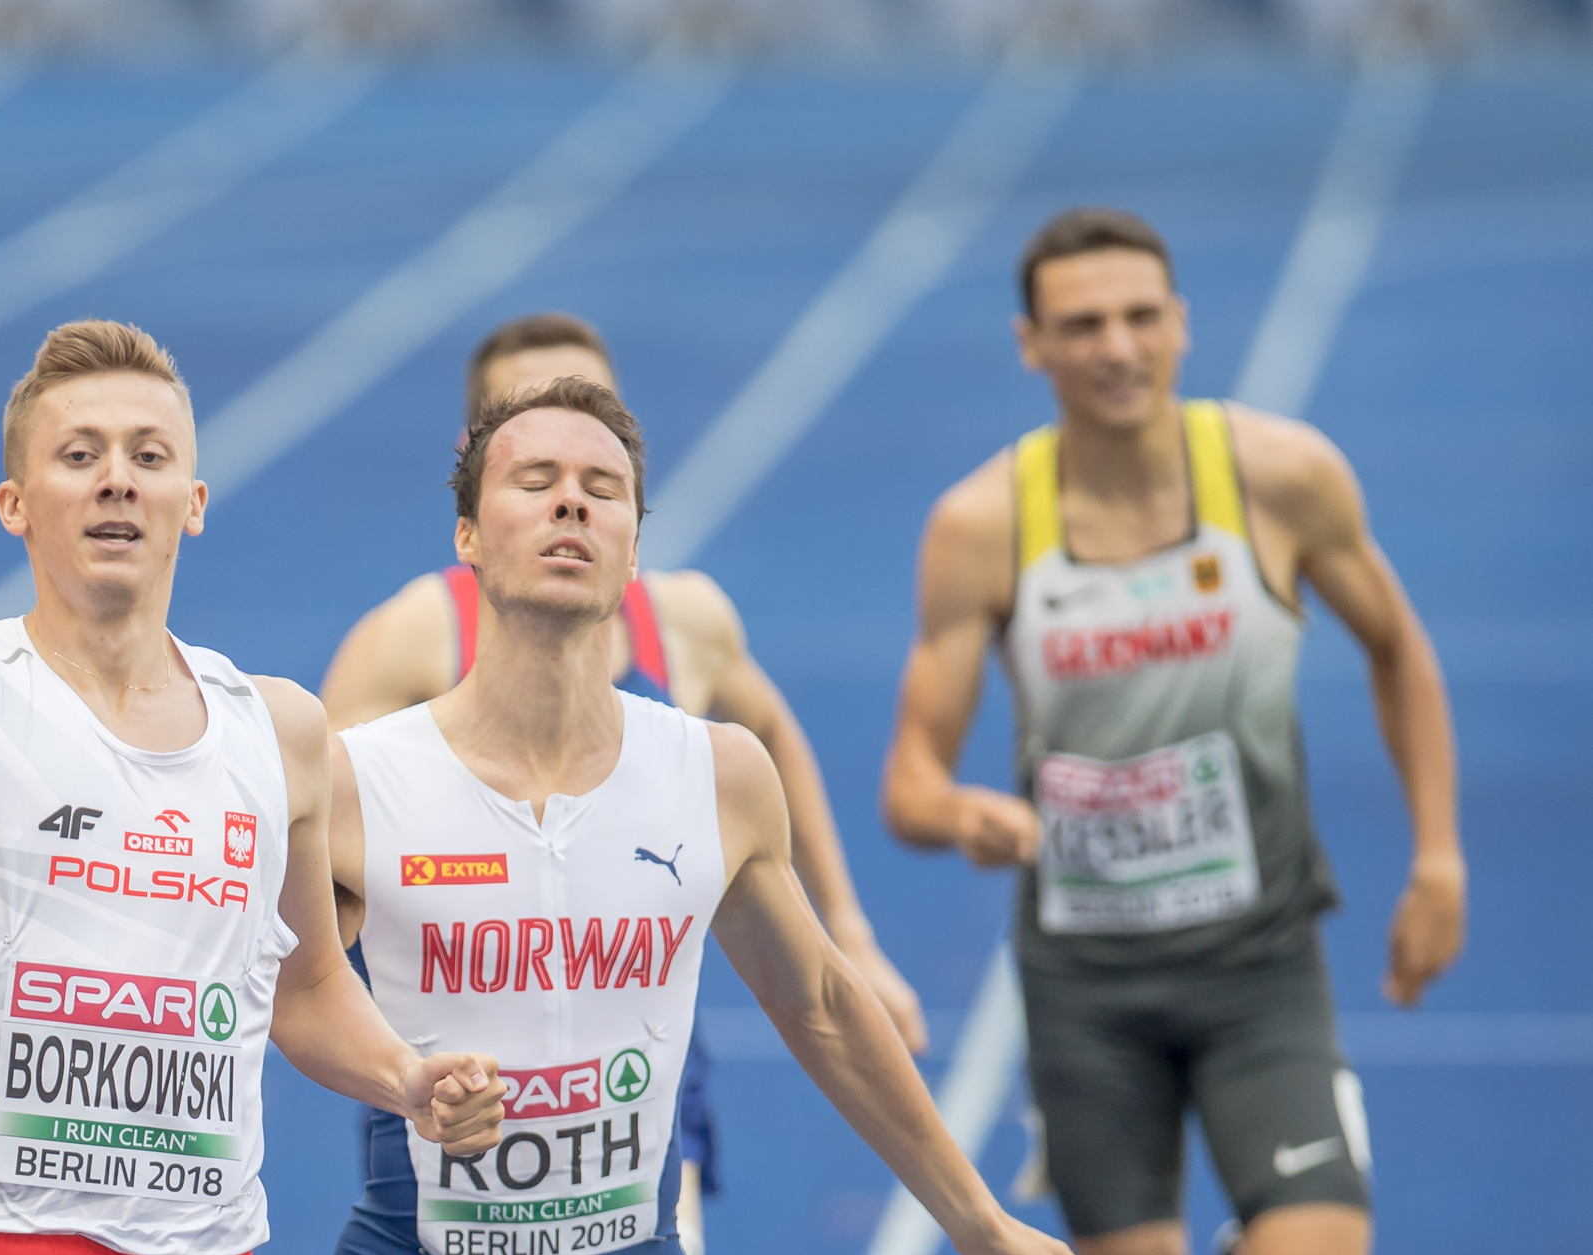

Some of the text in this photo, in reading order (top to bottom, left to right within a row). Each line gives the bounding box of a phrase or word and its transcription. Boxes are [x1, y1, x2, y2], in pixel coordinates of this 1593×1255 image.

[227, 813, 255, 825] POLSKA
[127, 835, 189, 854] ORLEN
[48, 855, 249, 913] POLSKA
[441, 860, 504, 878] EXTRA
[419, 915, 694, 994] NORWAY
[18, 969, 193, 1029] SPAR
[5, 1032, 235, 1123] BORKOWSKI
[53, 1120, 59, 1138] I
[67, 1123, 113, 1145] RUN
[439, 1111, 641, 1191] ROTH
[14, 1146, 224, 1197] BERLIN 2018
[476, 1204, 482, 1220] I
[489, 1204, 535, 1221] RUN
[571, 1214, 637, 1251] 2018
